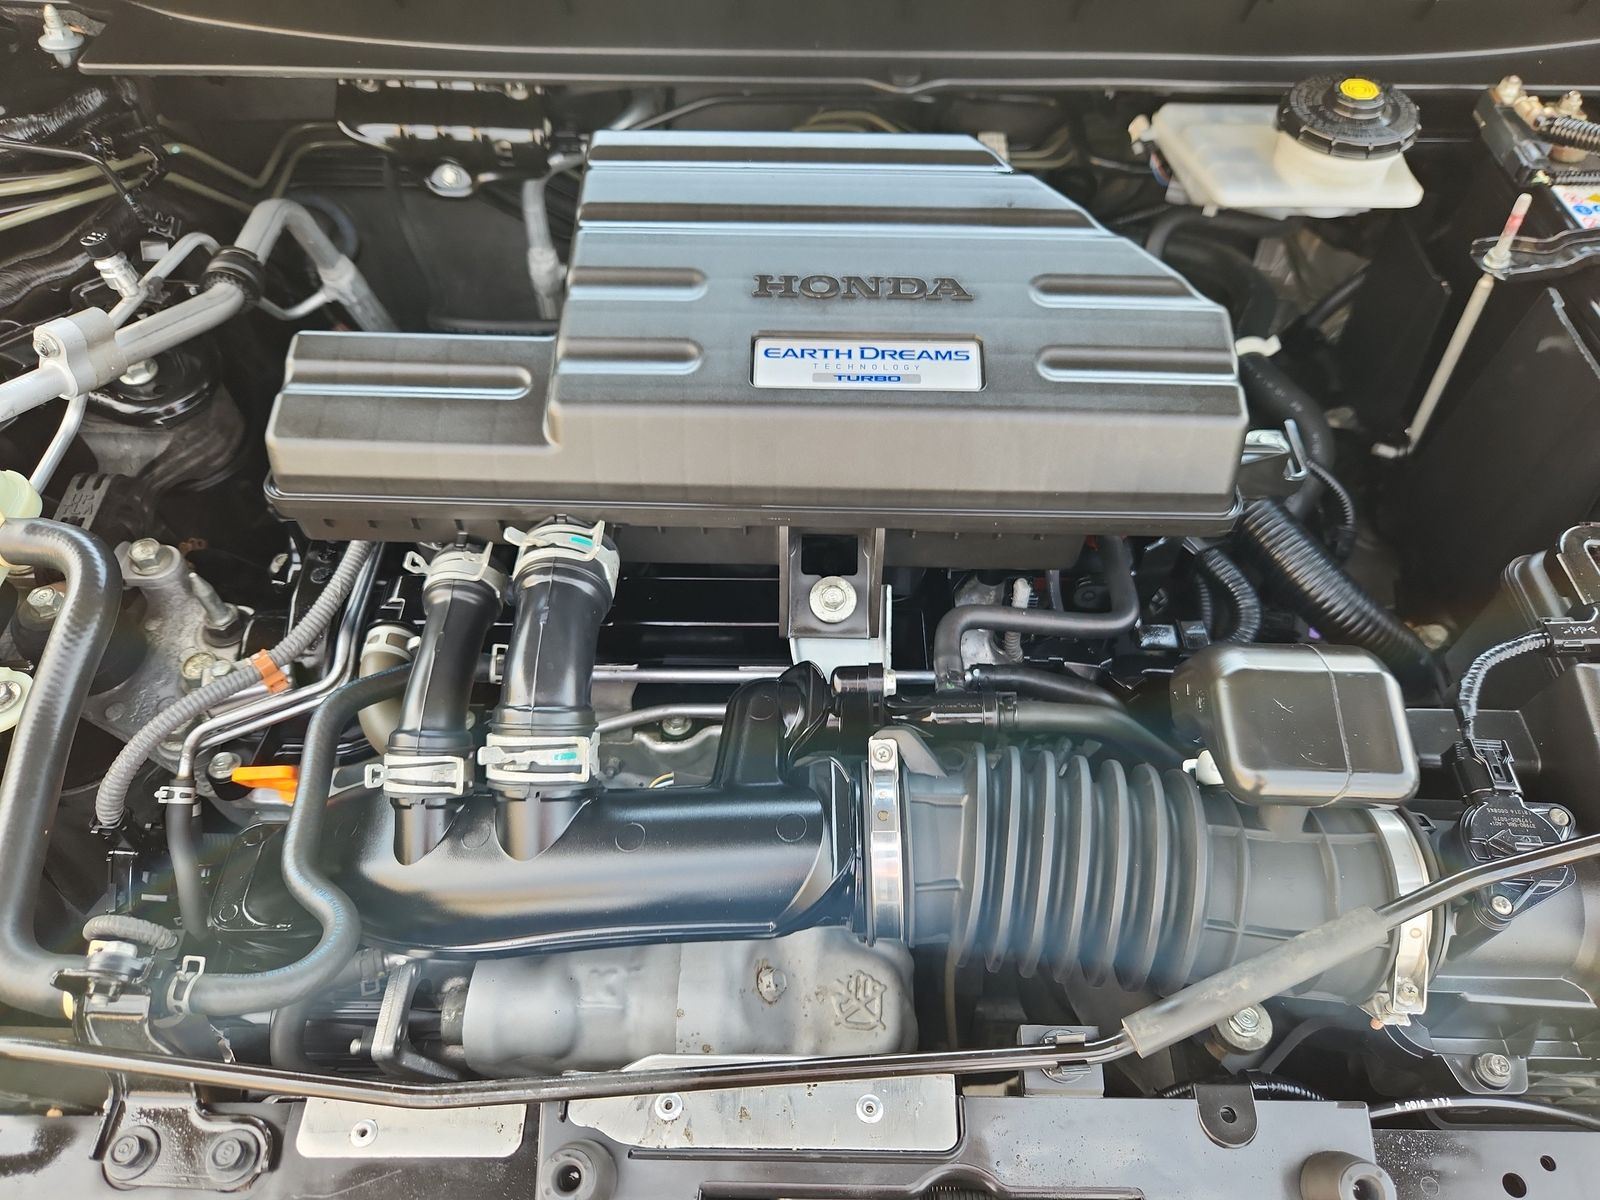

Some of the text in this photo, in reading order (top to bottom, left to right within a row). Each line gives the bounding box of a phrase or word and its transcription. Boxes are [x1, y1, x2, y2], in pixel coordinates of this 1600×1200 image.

[751, 274, 975, 301] HONDA
[763, 346, 970, 361] EARTH DREAMS
[813, 363, 920, 371] TECHNOLOGY
[833, 374, 901, 383] TURBO
